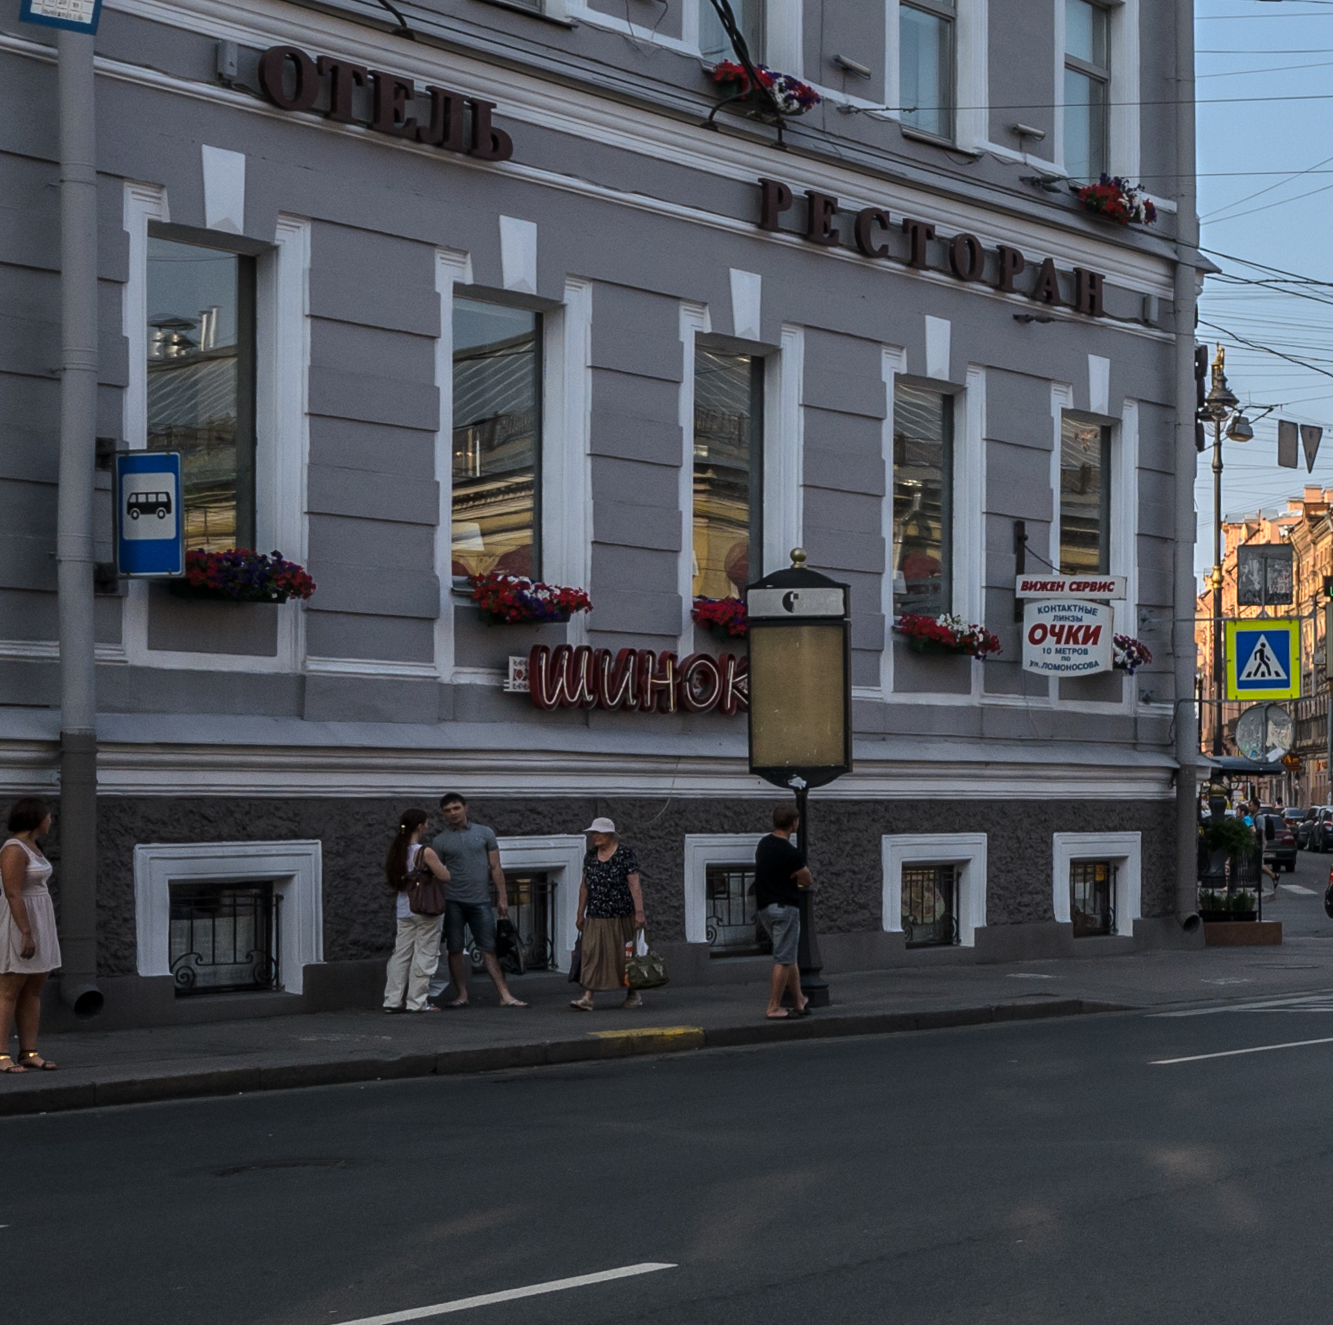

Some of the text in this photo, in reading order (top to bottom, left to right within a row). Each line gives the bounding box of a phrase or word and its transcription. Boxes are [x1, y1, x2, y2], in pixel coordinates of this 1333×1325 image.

[258, 45, 513, 162] ОТЕЛЬ
[757, 178, 1106, 317] РЕСТОРАН
[1020, 580, 1115, 592] ВИЖЕН СЕРВИС
[1037, 604, 1098, 616] КОНТАКТНЫЕ
[1027, 622, 1102, 646] ОЧКИ
[1042, 647, 1089, 656] 10 МЕТРОВ
[1041, 660, 1100, 672] ЛОМОНОСОВА
